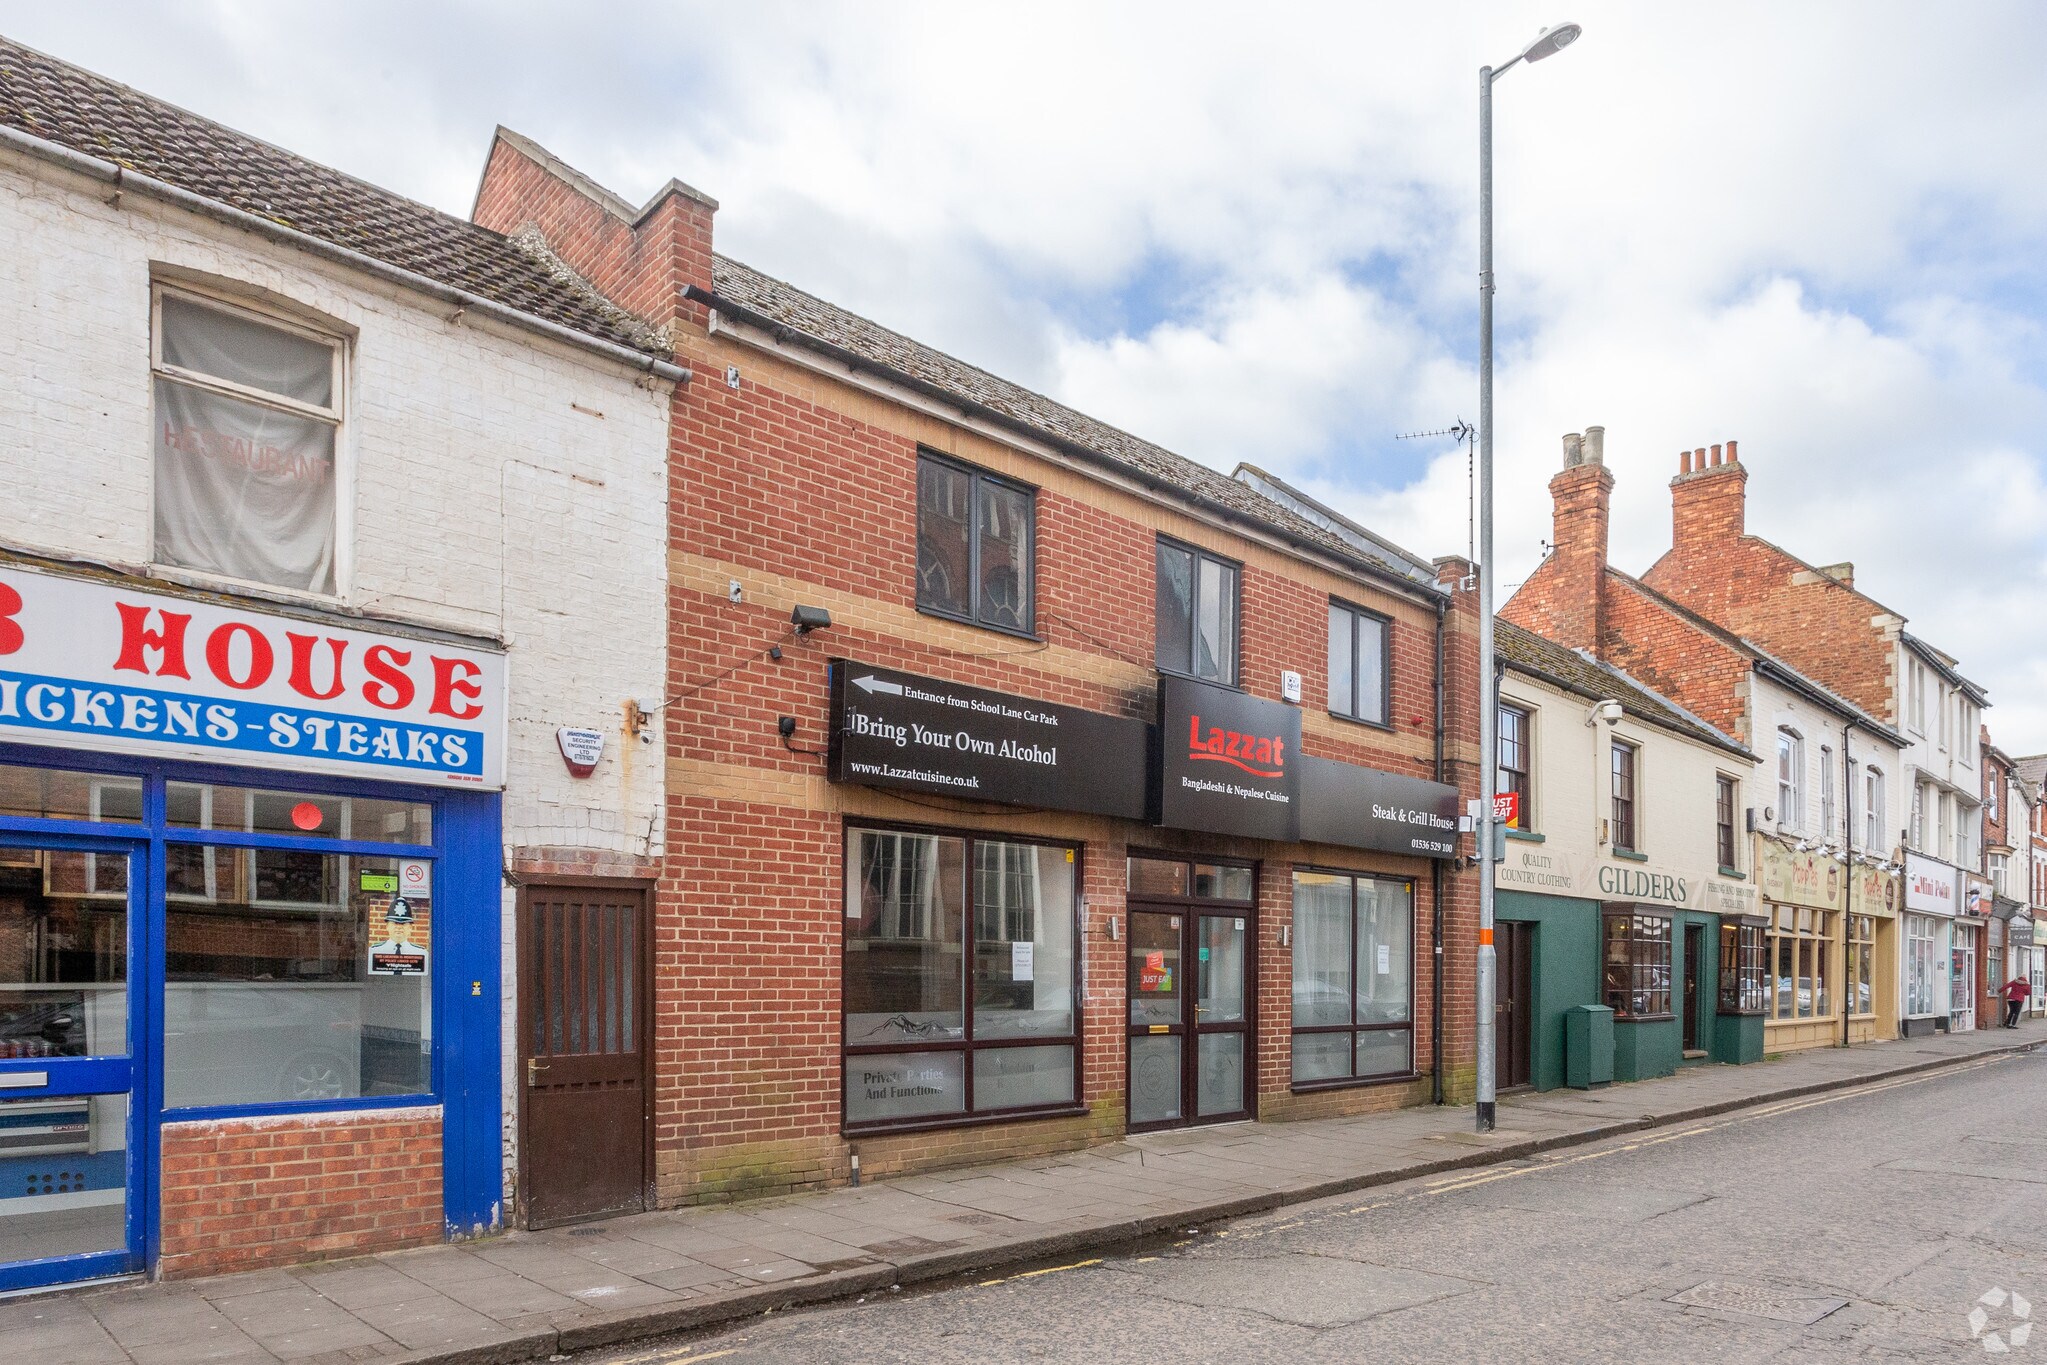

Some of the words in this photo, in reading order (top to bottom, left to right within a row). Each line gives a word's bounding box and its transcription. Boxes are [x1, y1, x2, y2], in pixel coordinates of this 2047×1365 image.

[113, 601, 484, 720] HOUSE
[904, 686, 945, 704] Entrance
[947, 695, 969, 709] from
[971, 700, 1000, 715] School
[1002, 706, 1022, 719] Lane
[1024, 710, 1038, 722] Car
[1040, 713, 1058, 726] Park
[567, 743, 602, 751] ENGINEERING
[572, 737, 597, 745] SECURITY
[856, 713, 907, 747] Bring
[911, 723, 952, 748] Your
[955, 731, 995, 756] Own
[998, 739, 1057, 766] Alcohol
[1189, 715, 1284, 766] Lazzat
[851, 762, 979, 788] www.Lazzatcuisine.co.uk
[1182, 776, 1225, 793] Bangladeshi
[1226, 784, 1233, 794] &
[1234, 785, 1264, 799] Nepalese
[1265, 790, 1289, 803] Cuisine
[1493, 797, 1512, 807] UST
[1493, 807, 1512, 817] EAT
[1372, 804, 1397, 821] Steak
[1398, 808, 1407, 822] &
[1408, 810, 1428, 826] Grill
[1429, 813, 1454, 830] House
[1411, 839, 1429, 850] 01536
[1430, 841, 1441, 852] 529
[1442, 843, 1453, 853] 100
[1522, 853, 1552, 869] QUALITY
[1501, 868, 1536, 884] COUNTRY
[1537, 873, 1572, 888] CLOTHING
[1598, 865, 1687, 903] GILDERS
[1142, 975, 1157, 984] JUST
[865, 1086, 887, 1100] And
[890, 1085, 943, 1098] Functions
